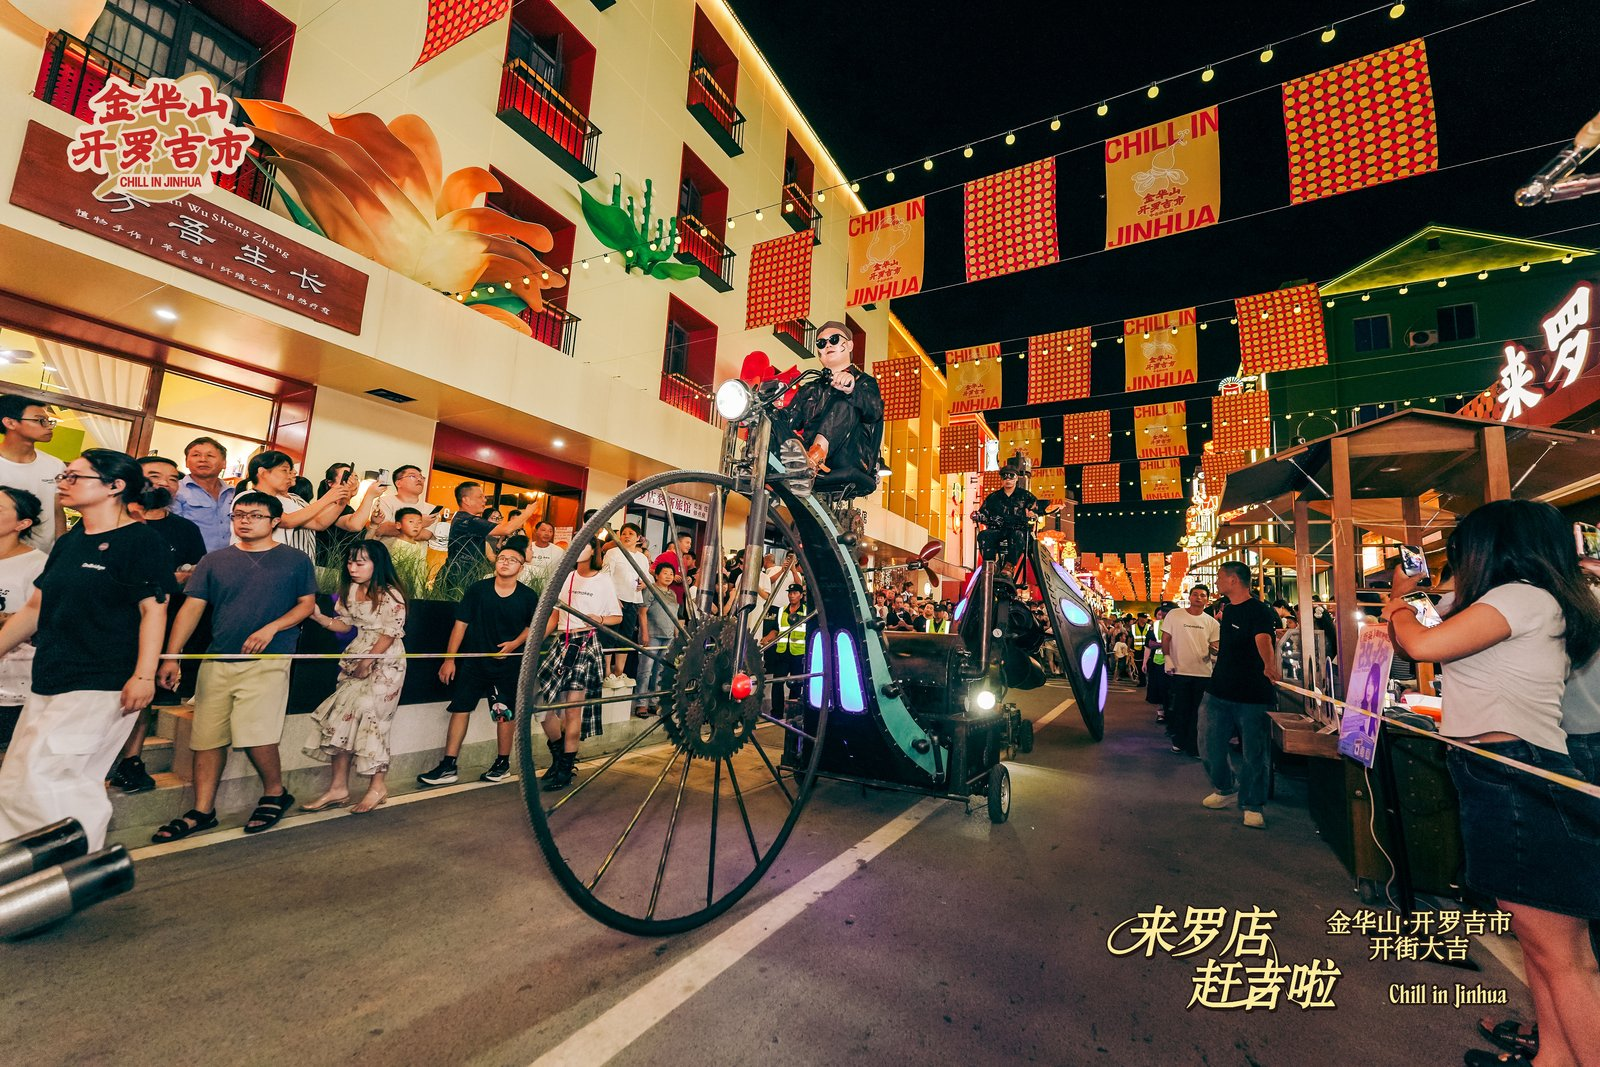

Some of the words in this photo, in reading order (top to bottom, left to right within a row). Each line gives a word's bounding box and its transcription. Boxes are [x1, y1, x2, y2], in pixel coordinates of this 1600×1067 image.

[1105, 122, 1182, 164] CHILL
[1191, 105, 1219, 140] IN
[1138, 195, 1186, 215] 开罗吉市
[1143, 187, 1181, 204] 金华山
[848, 206, 900, 237] CHILL
[906, 198, 925, 222] IN
[1108, 204, 1216, 248] JINHUA
[187, 202, 209, 218] Wu
[212, 213, 250, 237] Sheng
[252, 232, 290, 259] Zhang
[847, 276, 920, 306] JINHUA
[1123, 313, 1173, 336] CHILL
[1179, 307, 1196, 326] IN
[987, 344, 1002, 359] IN
[1126, 368, 1195, 392] JINHUA
[947, 396, 1000, 414] JINHUA
[1134, 404, 1169, 419] CHILL
[1173, 401, 1187, 414] IN
[1138, 444, 1187, 459] JINHUA
